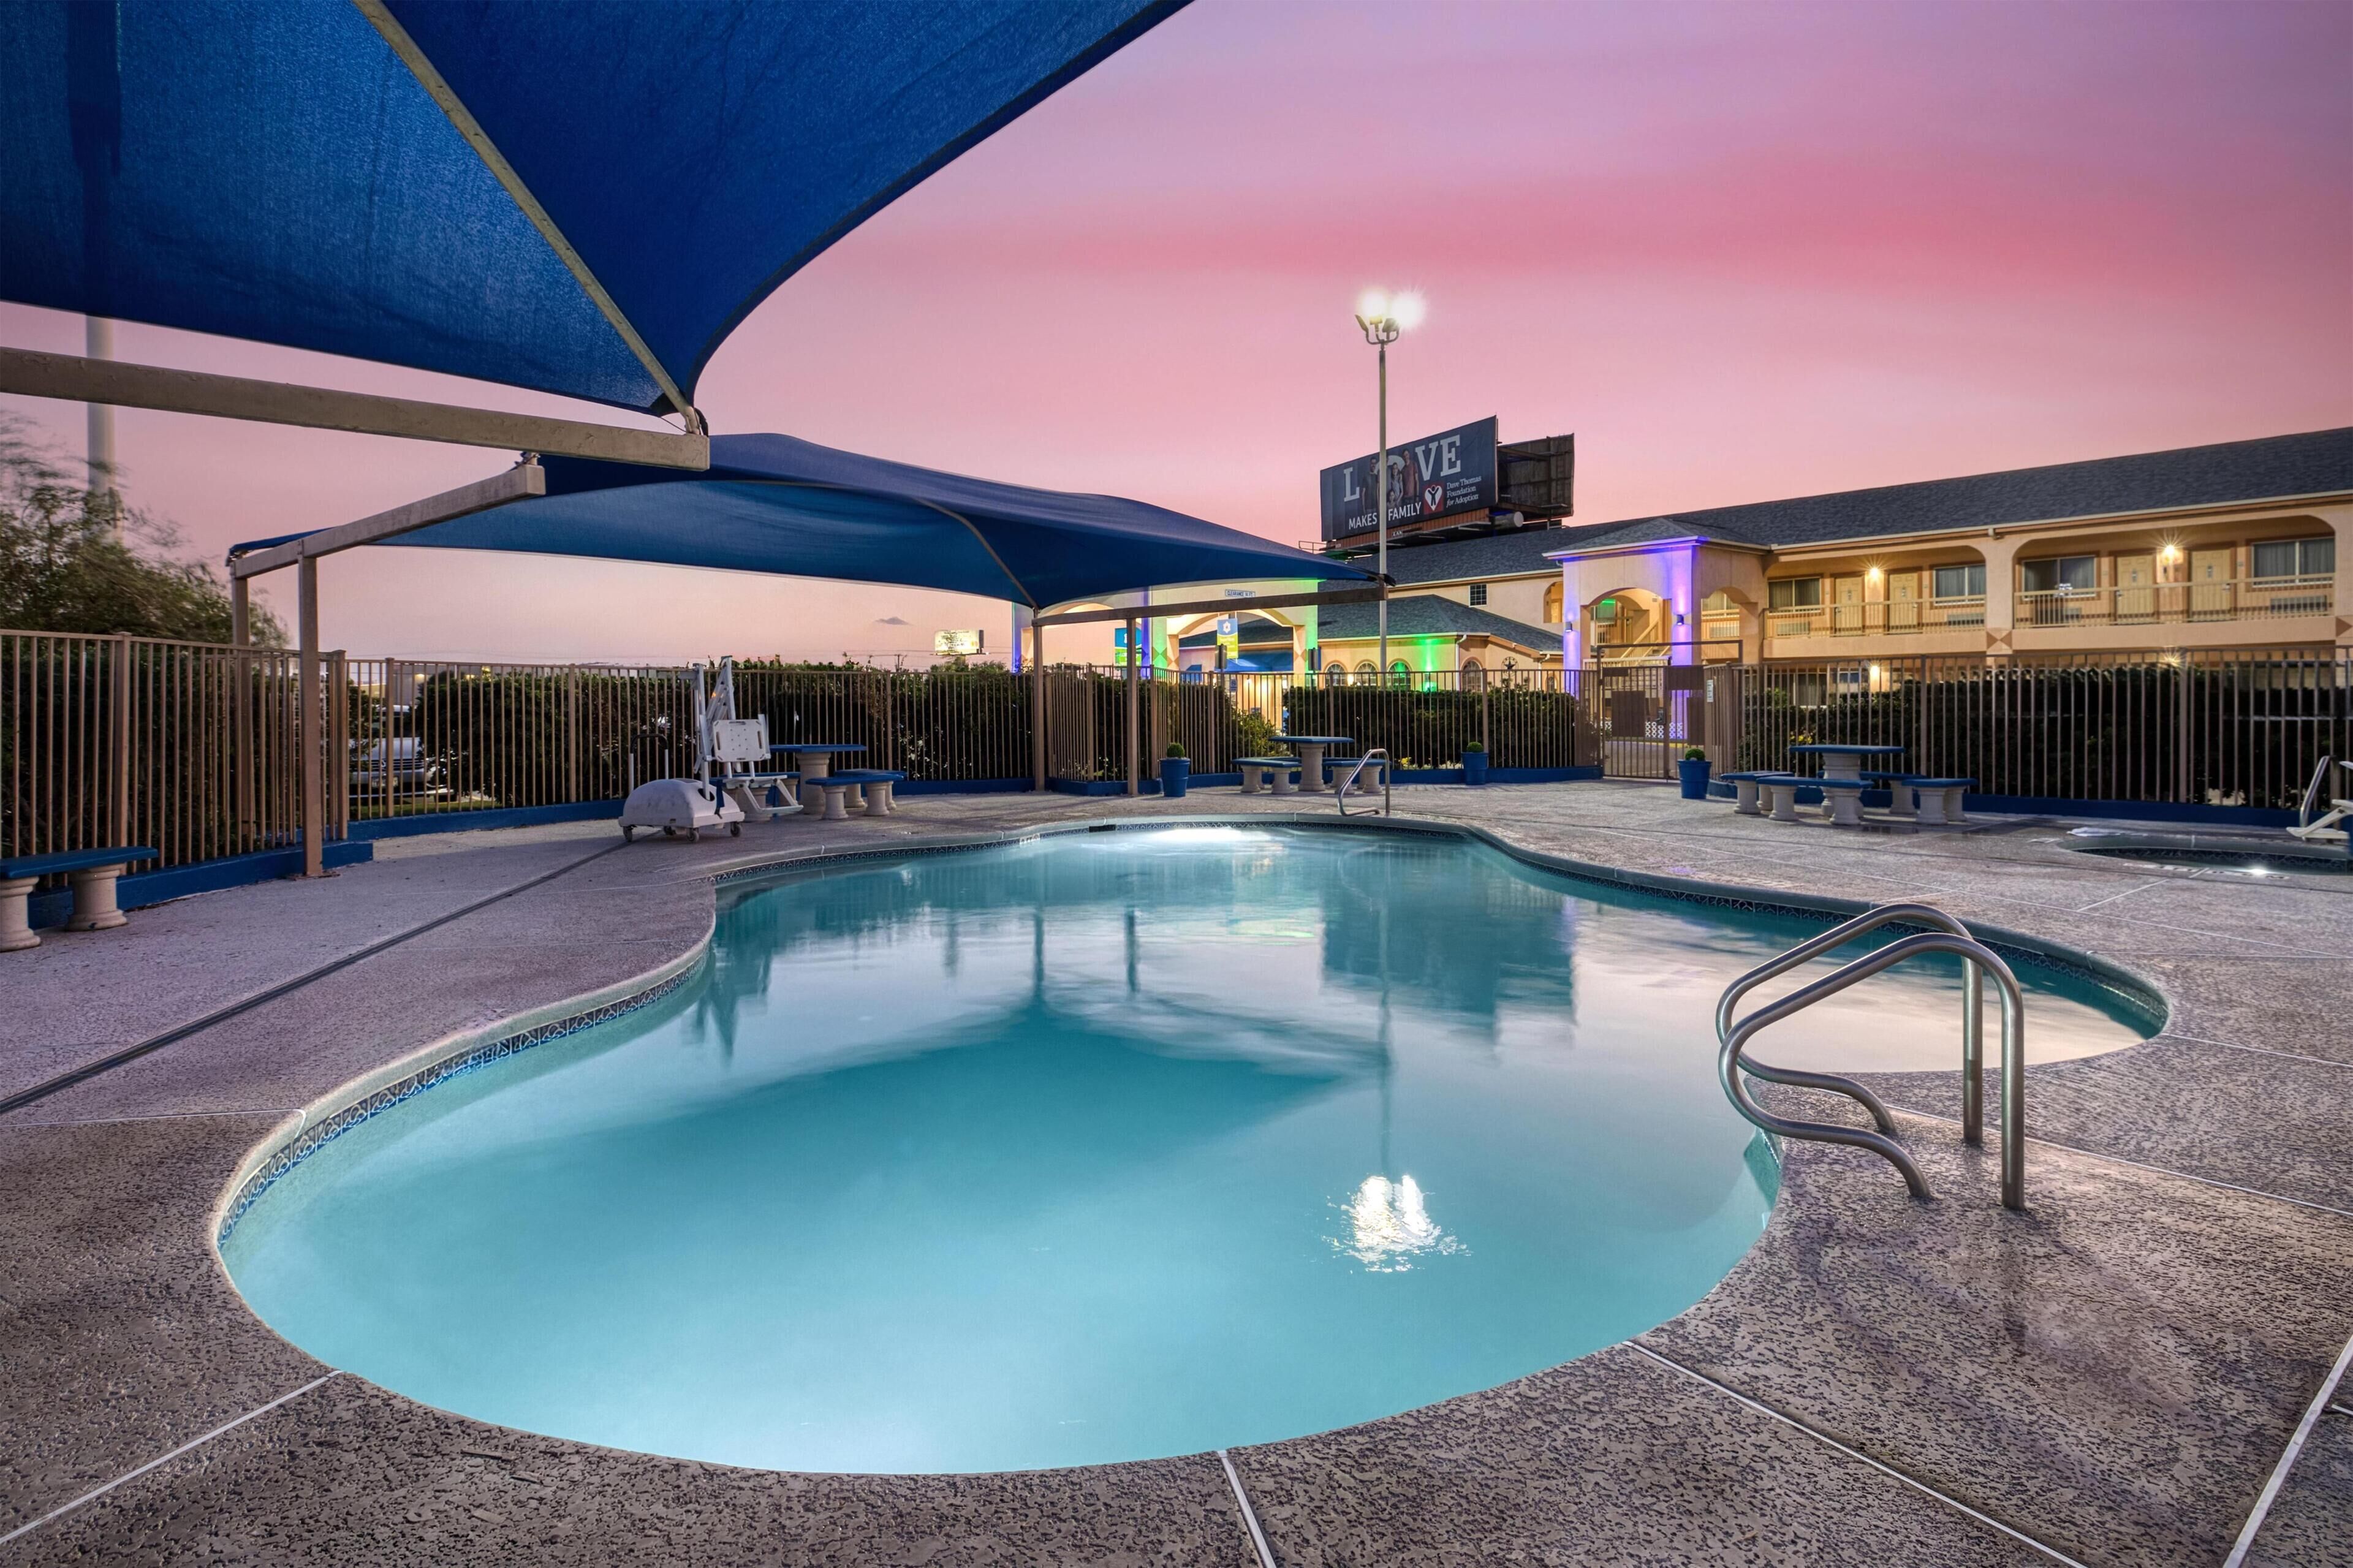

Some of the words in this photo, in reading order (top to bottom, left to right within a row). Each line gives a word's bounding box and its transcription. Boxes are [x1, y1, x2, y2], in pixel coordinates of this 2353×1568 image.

[1460, 475, 1482, 486] Thomas
[1447, 485, 1476, 498] Foundation
[1446, 499, 1455, 508] for
[1455, 493, 1479, 504] Adoption
[1349, 512, 1377, 530] MAKES
[1388, 502, 1422, 521] FAMILY
